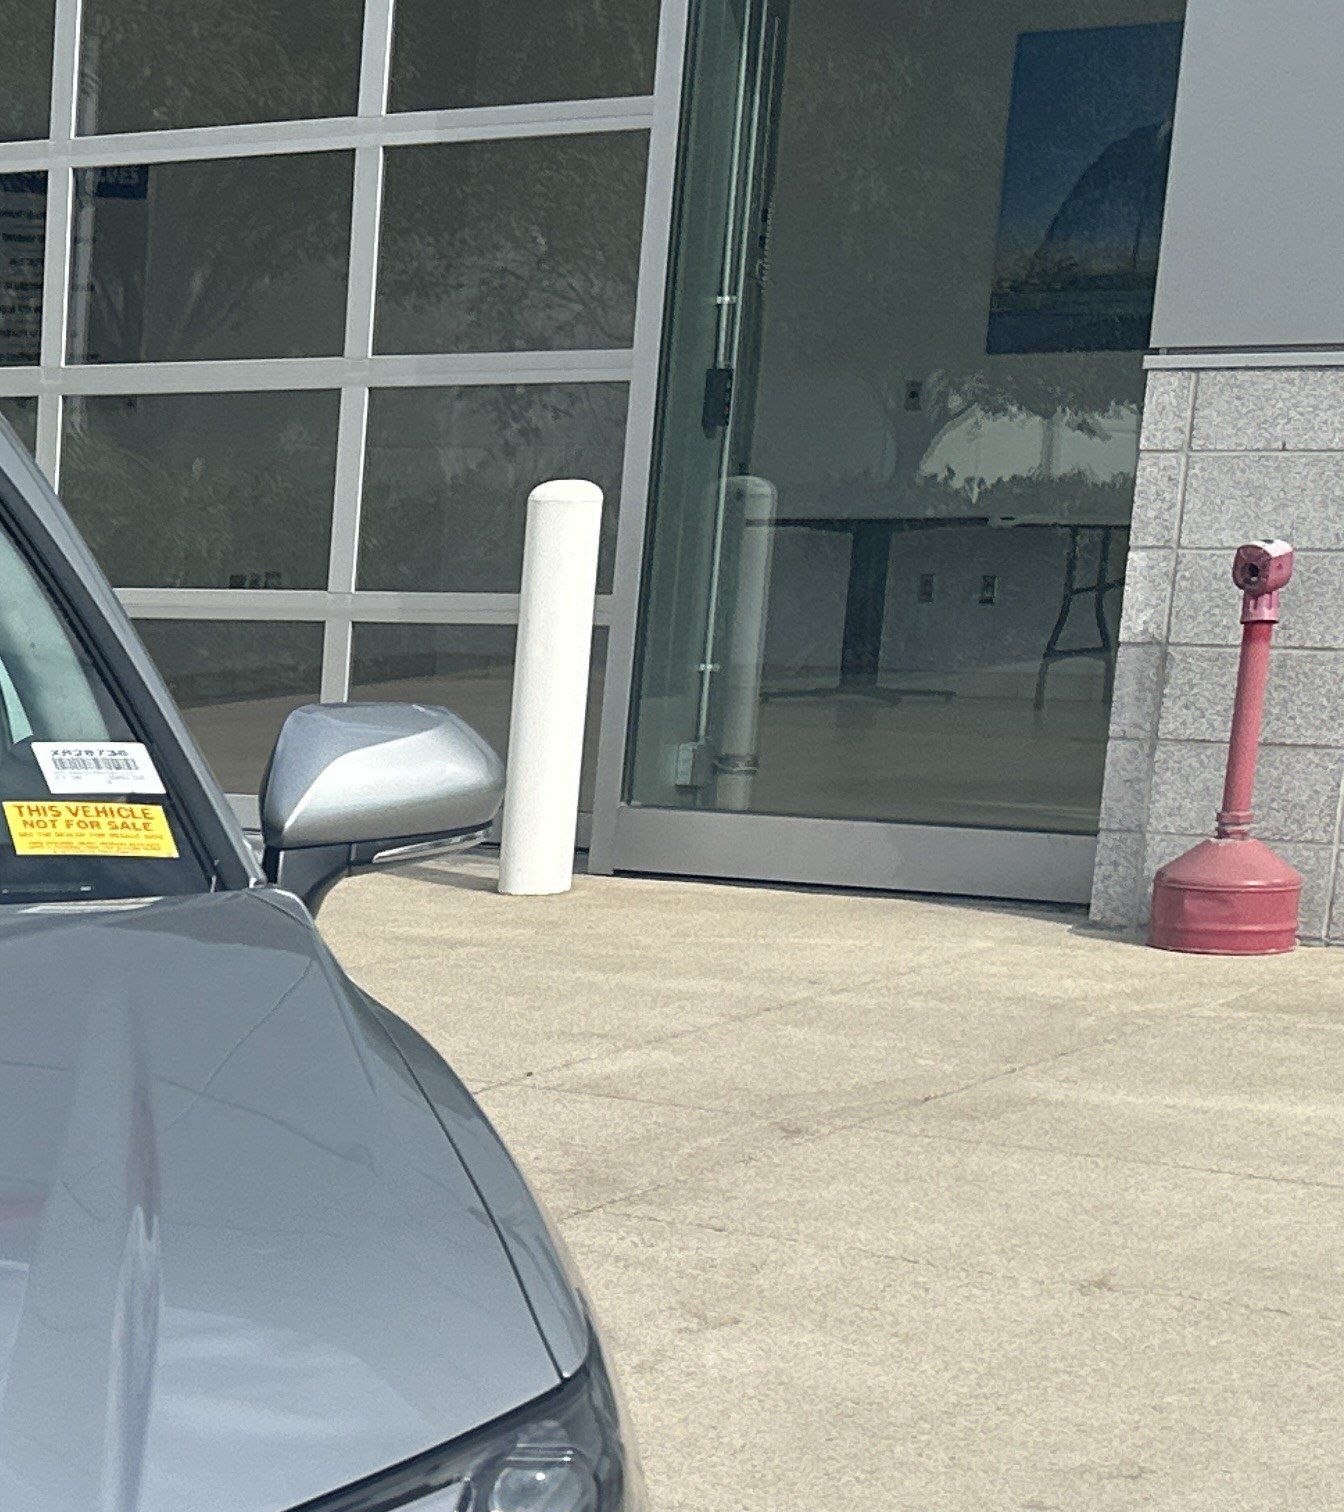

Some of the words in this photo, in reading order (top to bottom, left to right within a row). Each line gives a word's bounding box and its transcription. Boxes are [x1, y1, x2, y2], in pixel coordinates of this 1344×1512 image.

[13, 805, 62, 817] THIS
[65, 805, 154, 820] VEHICLE
[22, 819, 58, 829] NOT
[65, 819, 101, 830] FOR
[107, 820, 154, 832] SALE
